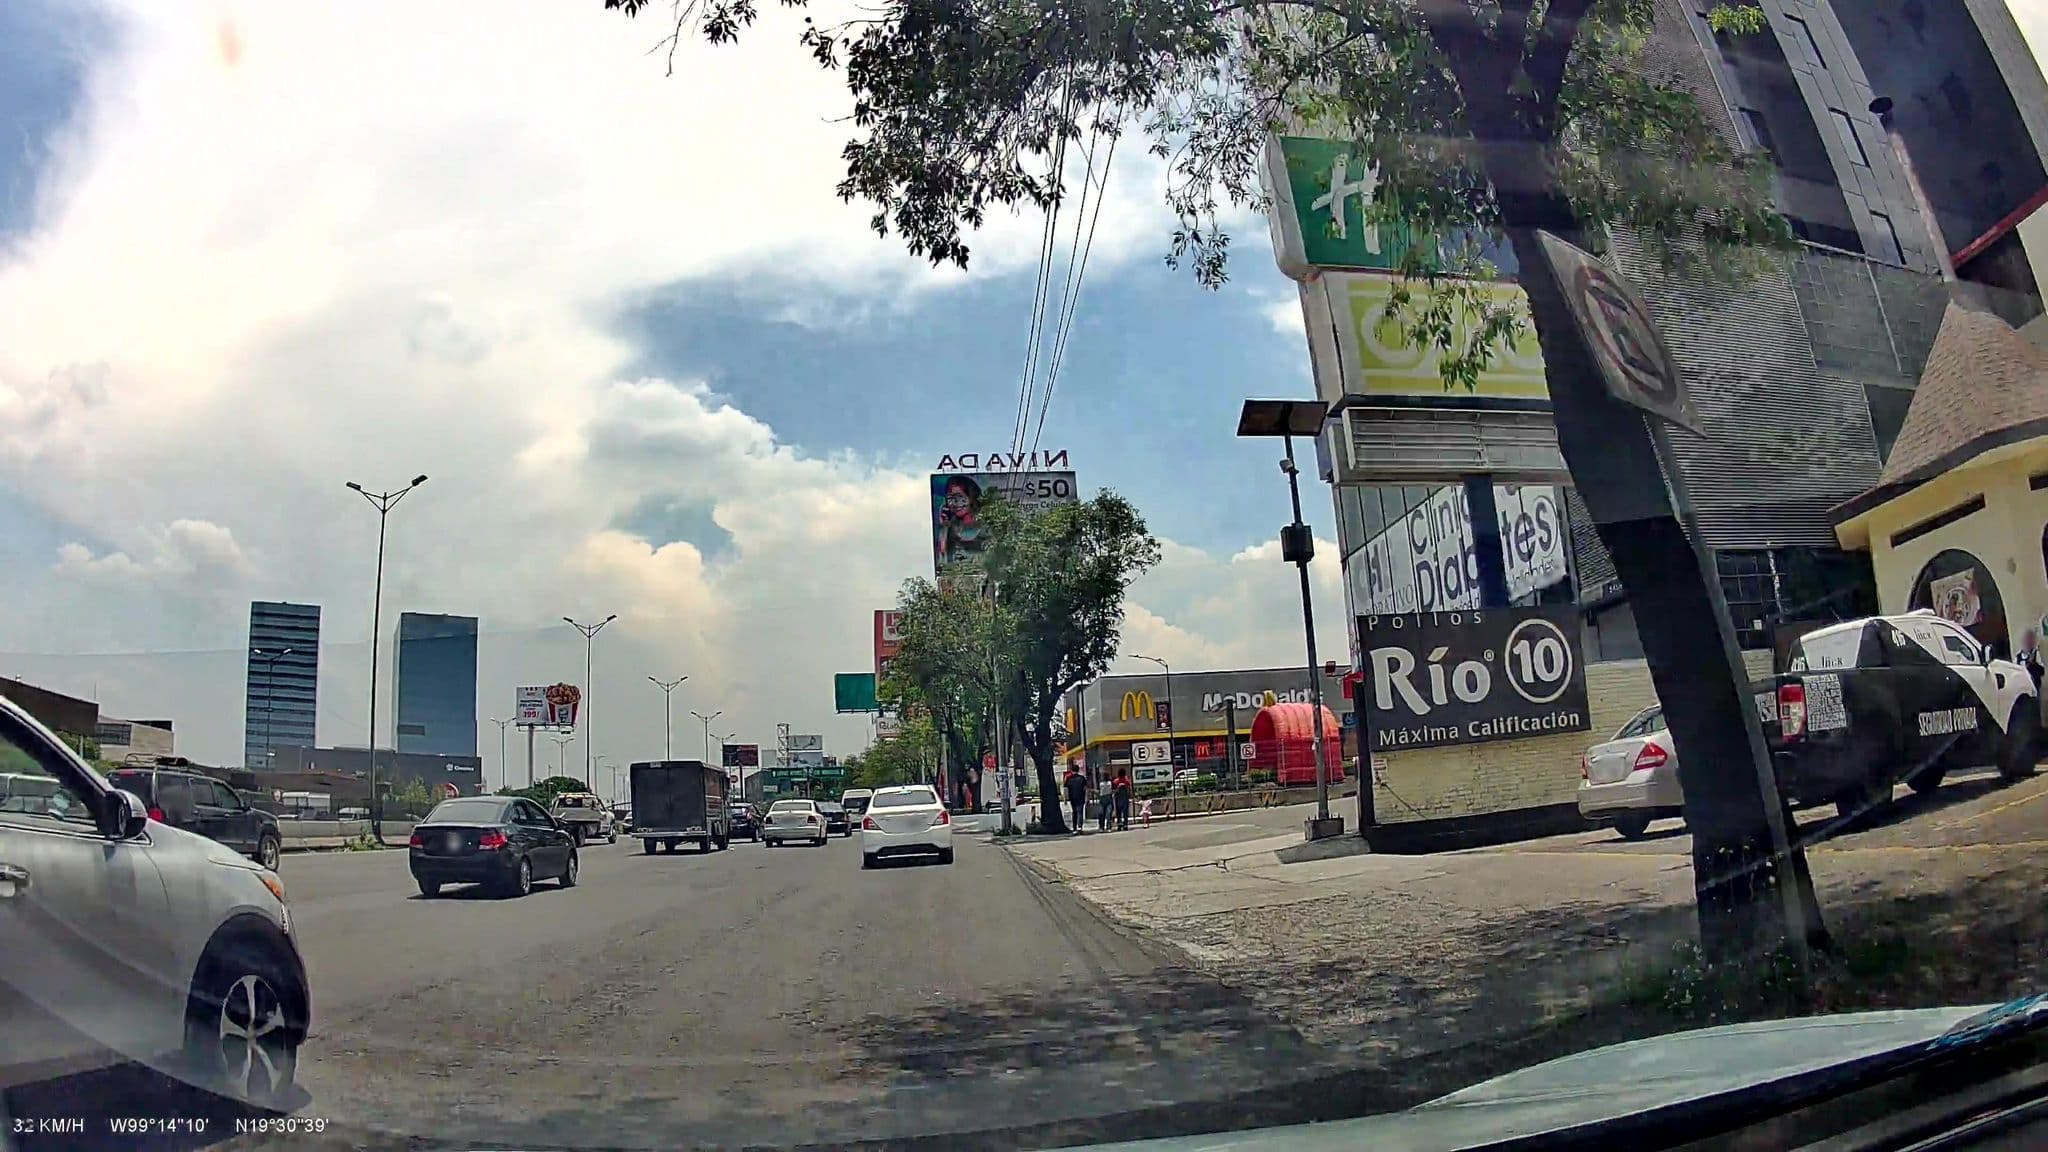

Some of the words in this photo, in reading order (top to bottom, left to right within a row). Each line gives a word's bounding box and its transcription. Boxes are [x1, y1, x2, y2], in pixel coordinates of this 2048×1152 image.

[1026, 479, 1070, 499] $50
[1369, 611, 1482, 632] Pollos
[1369, 646, 1491, 715] Río
[1513, 637, 1564, 683] 10
[1379, 725, 1459, 747] Máxima
[1468, 711, 1580, 737] Calificación
